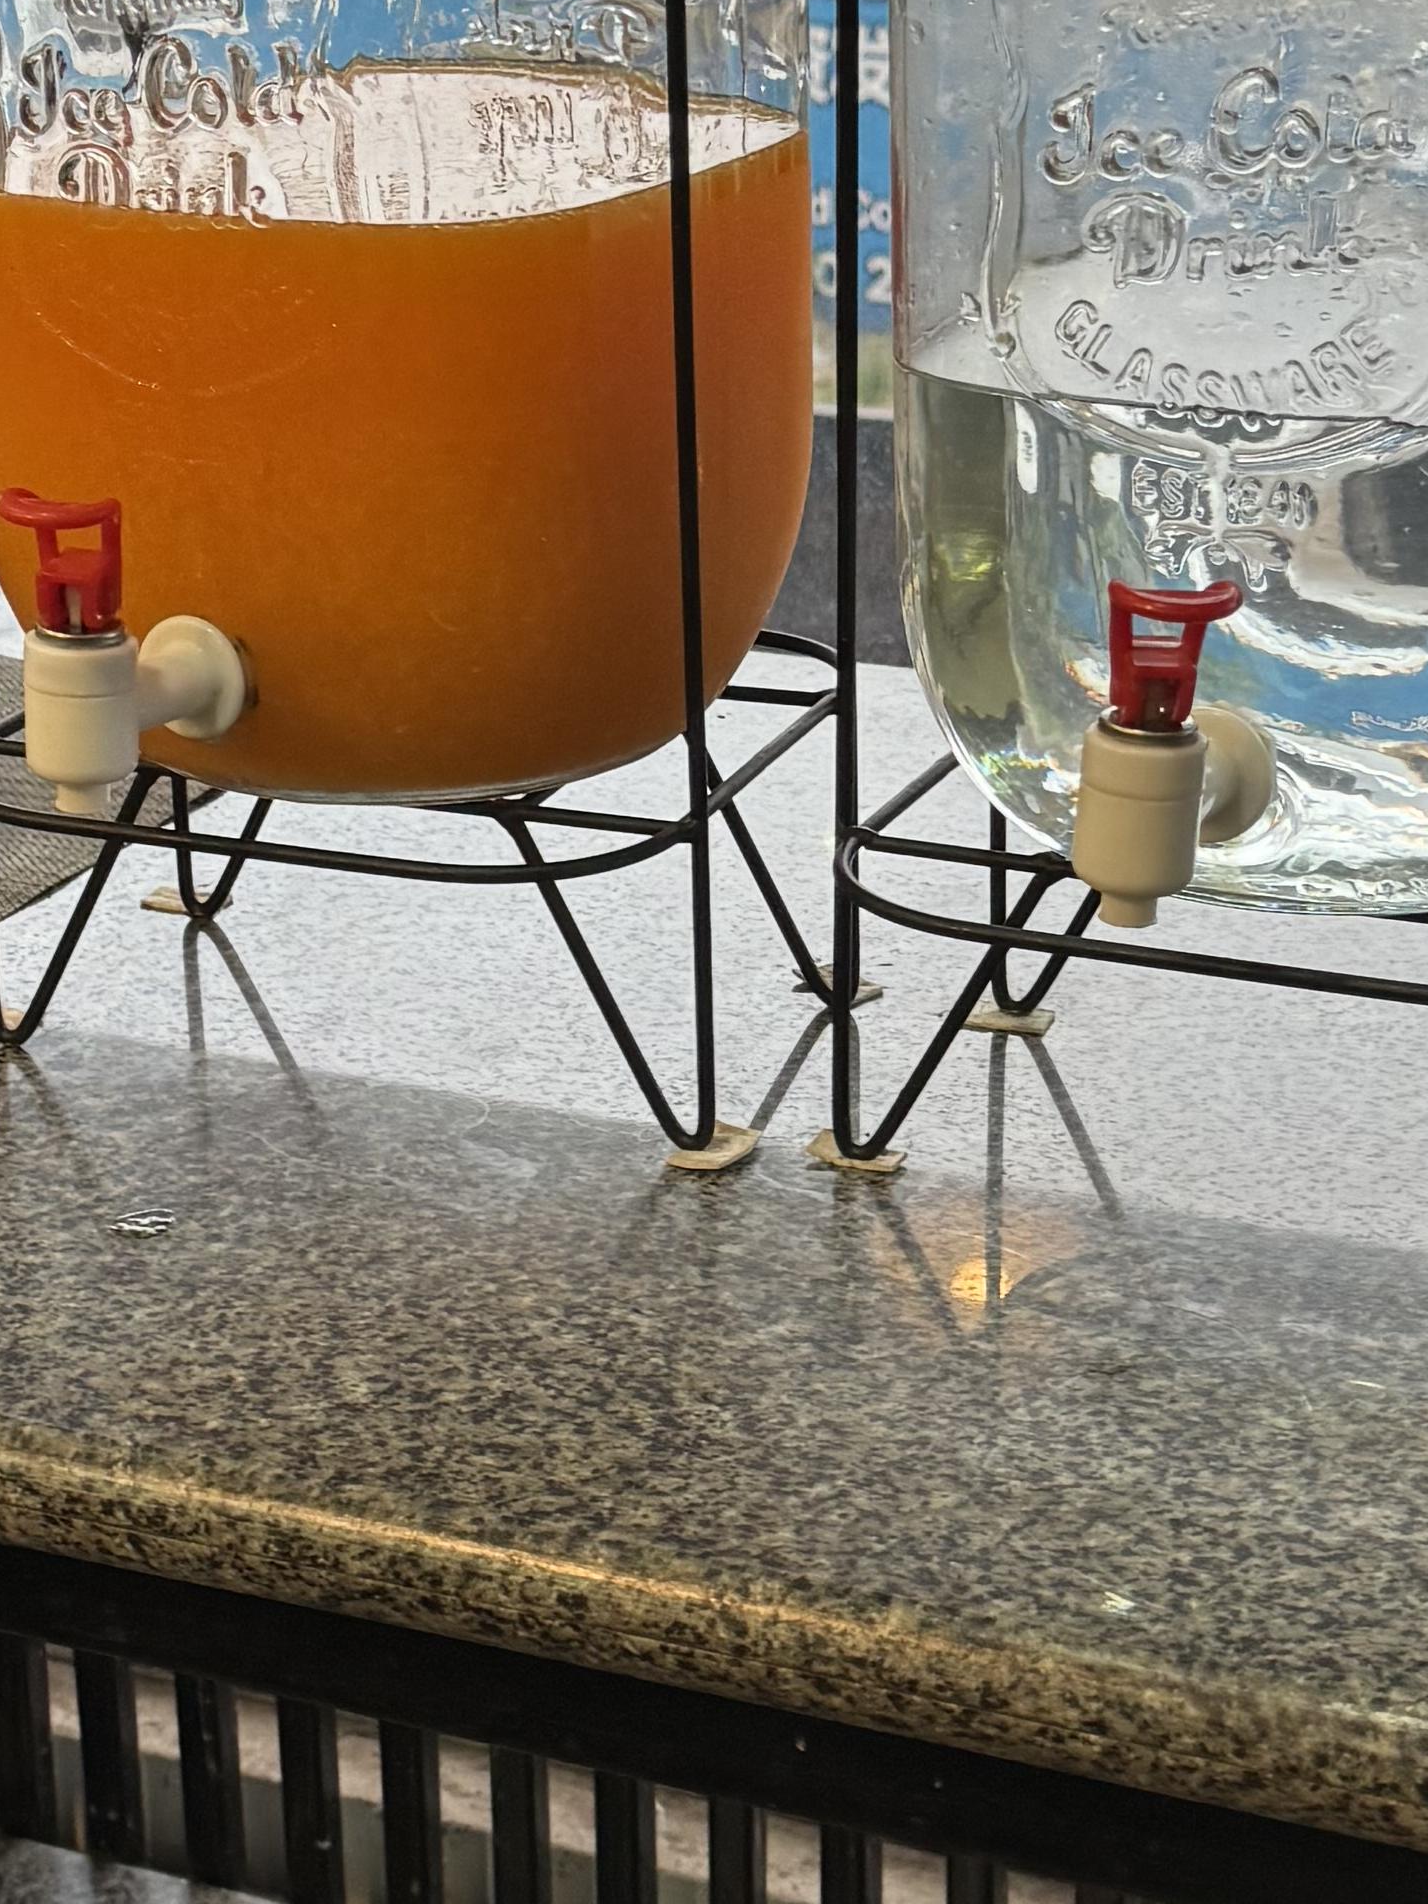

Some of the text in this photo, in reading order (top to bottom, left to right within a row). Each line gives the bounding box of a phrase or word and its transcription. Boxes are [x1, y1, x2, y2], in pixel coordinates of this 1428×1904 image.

[142, 33, 306, 134] Cold
[1039, 81, 1185, 188] Ice
[1054, 299, 1398, 418] GLASSWARE
